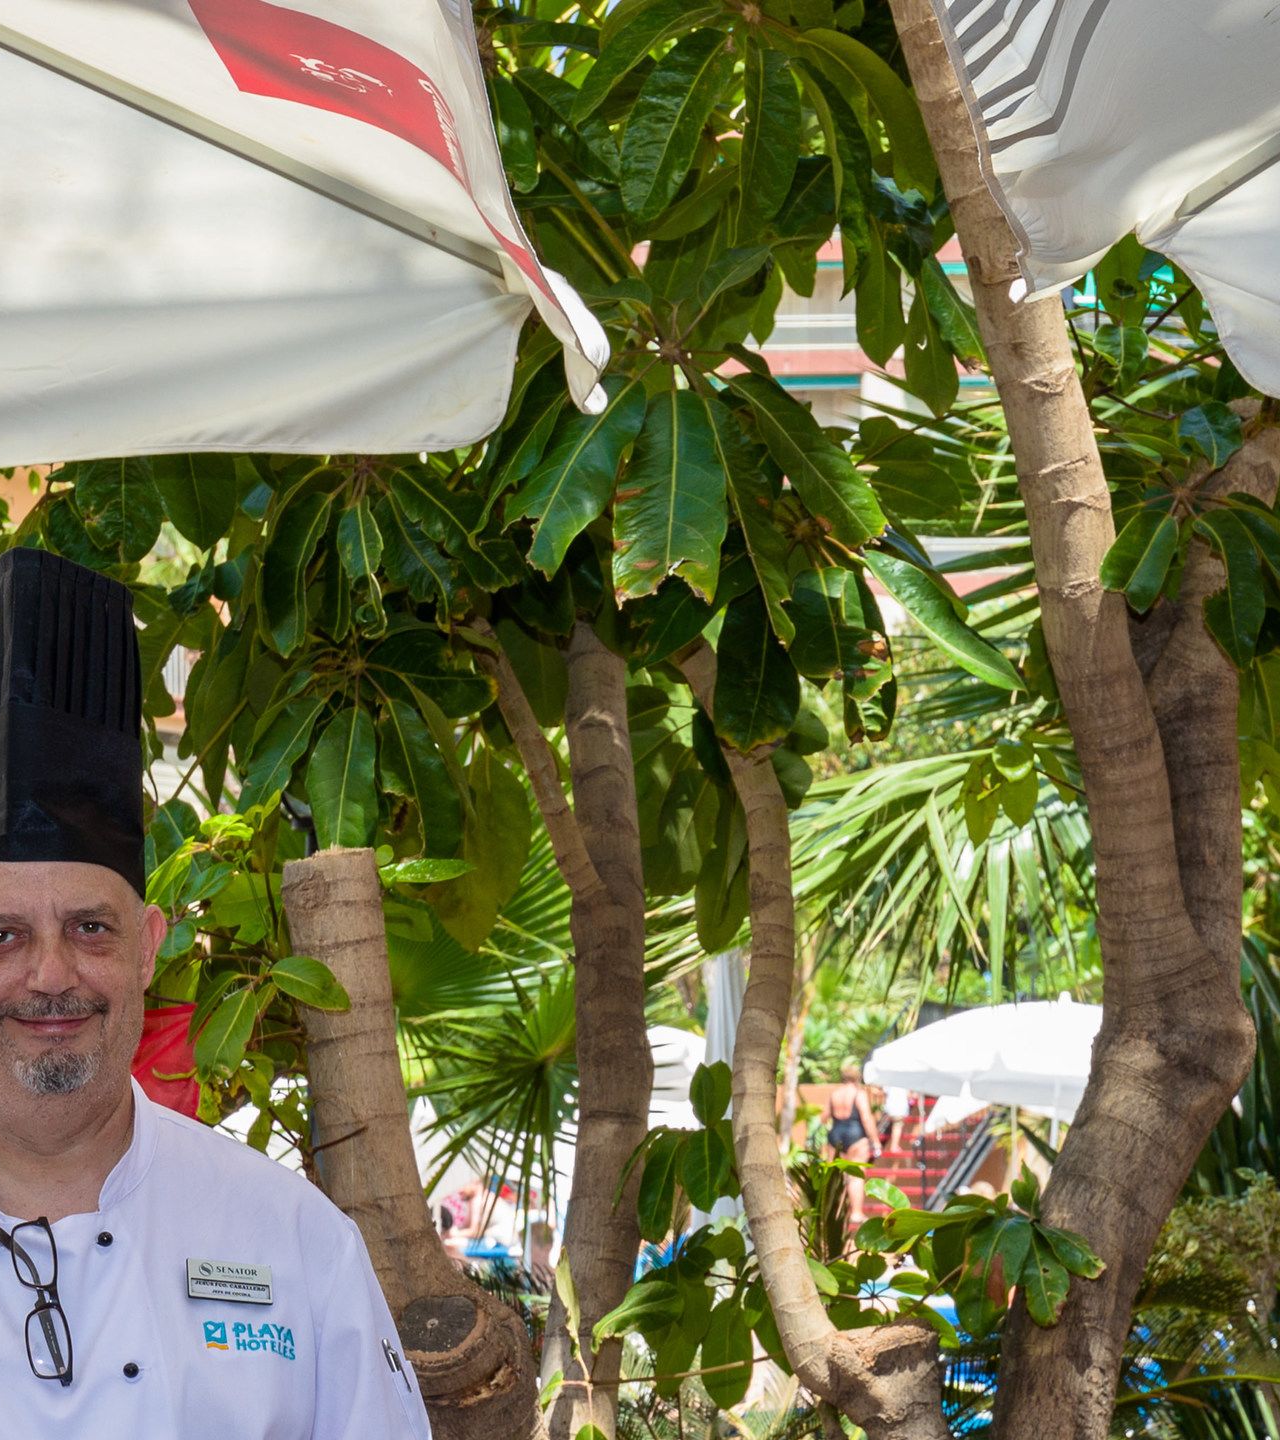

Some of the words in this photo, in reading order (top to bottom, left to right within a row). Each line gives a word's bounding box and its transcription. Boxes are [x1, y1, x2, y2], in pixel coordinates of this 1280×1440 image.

[216, 1266, 258, 1277] SENATOR
[229, 1283, 266, 1292] CABALLERO
[232, 1322, 295, 1347] PLAYA
[236, 1338, 296, 1360] HOTELES
